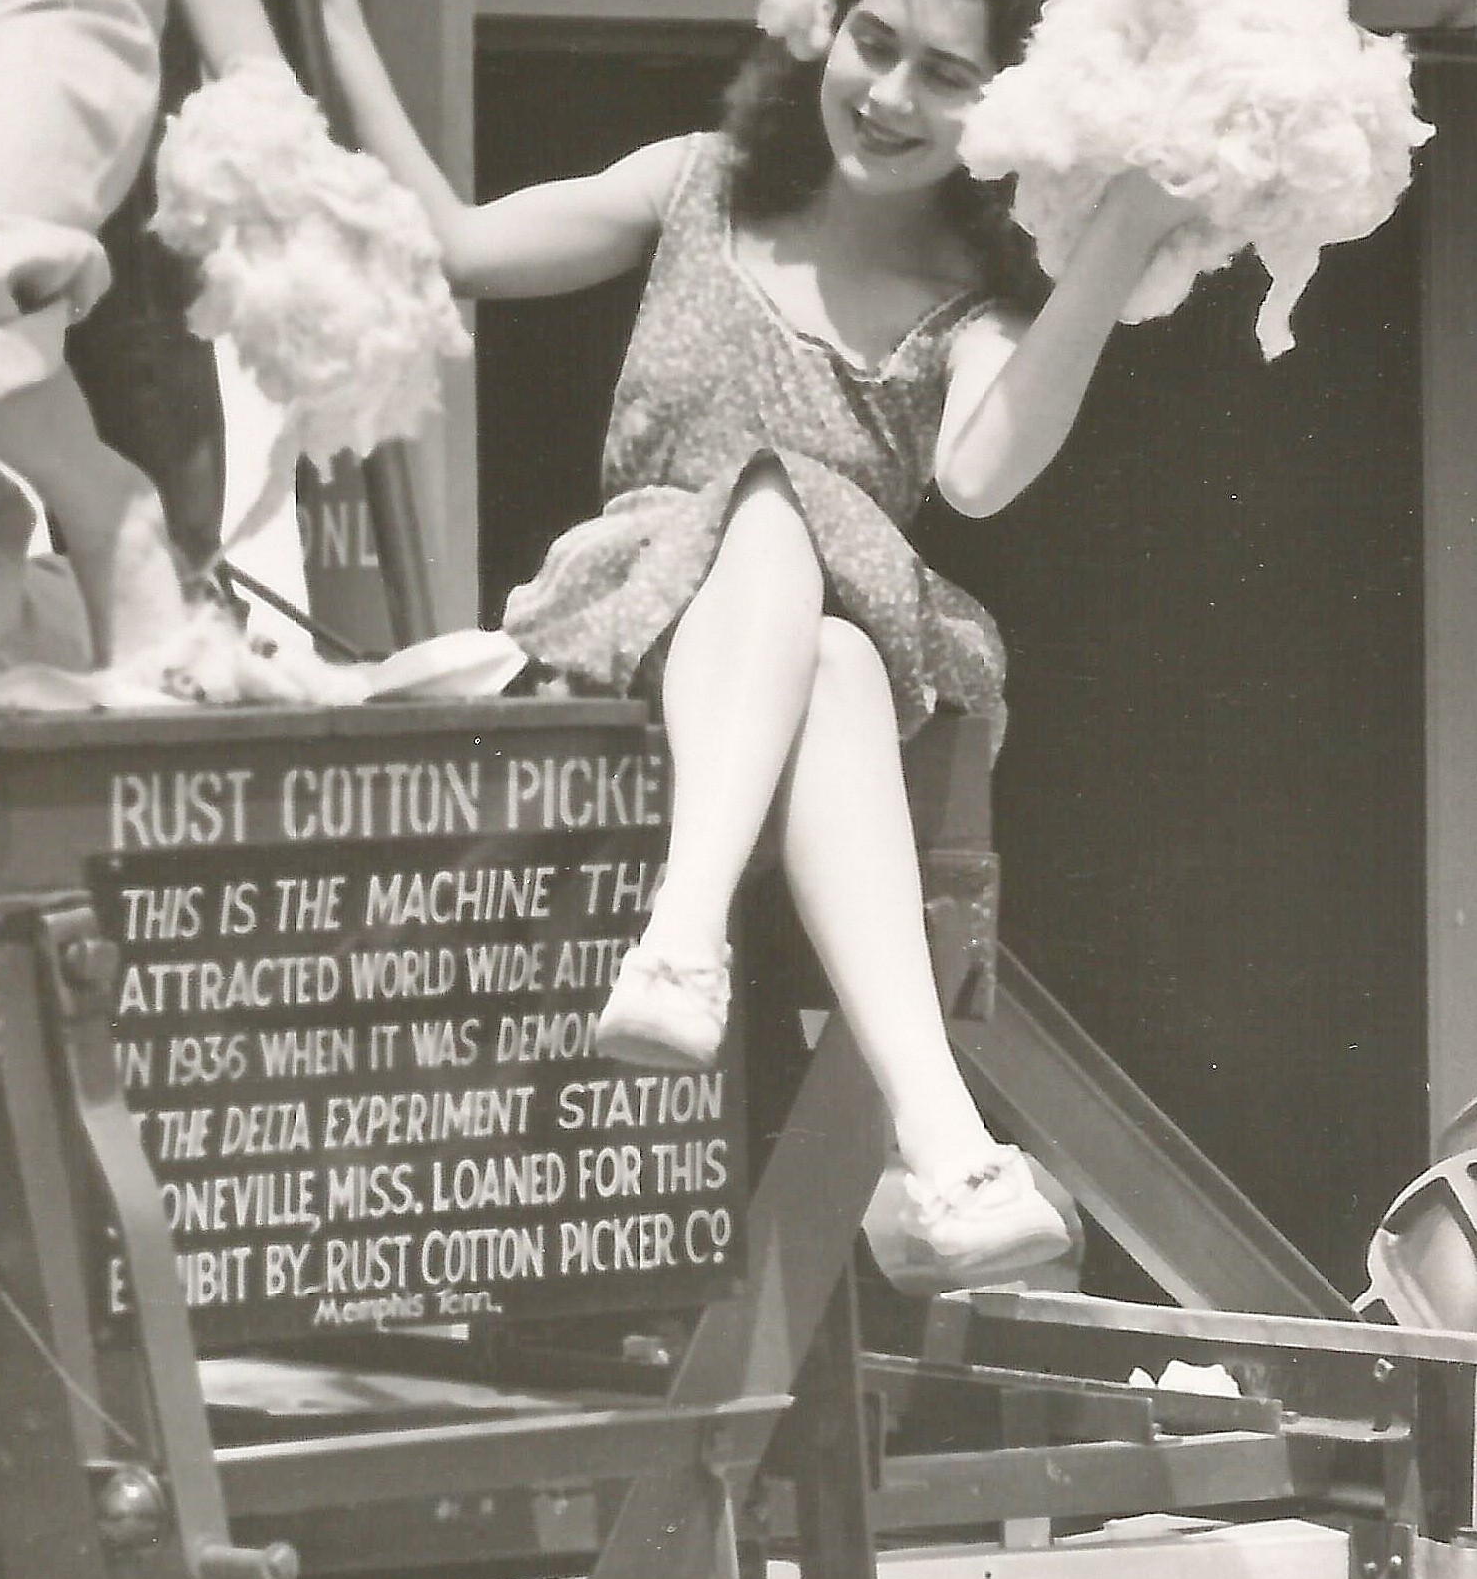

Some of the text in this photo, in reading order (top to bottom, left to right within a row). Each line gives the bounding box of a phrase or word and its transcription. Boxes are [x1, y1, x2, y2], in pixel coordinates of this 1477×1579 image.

[110, 755, 662, 850] RUST COTTON PICKE
[121, 885, 203, 941] THIS
[219, 882, 259, 936] IS
[276, 876, 346, 933] THE
[365, 866, 556, 927] MACHINE
[118, 937, 639, 1016] ATTRACTED WORLD WIDE ATTE
[113, 1042, 153, 1087] IN
[167, 1034, 247, 1087] 1936
[259, 1026, 356, 1079] WHEN
[370, 1024, 399, 1070] IT
[410, 1019, 480, 1068] WAS
[158, 1072, 723, 1160] THE DELTA EXPERIMENT STATION
[107, 1138, 729, 1239] ONEVILLE, MISS. LOANED FOR THIS
[109, 1245, 253, 1314] EIBIT
[326, 1234, 413, 1296] RUST
[422, 1225, 546, 1286] COTTON
[560, 1212, 677, 1275] PICKER
